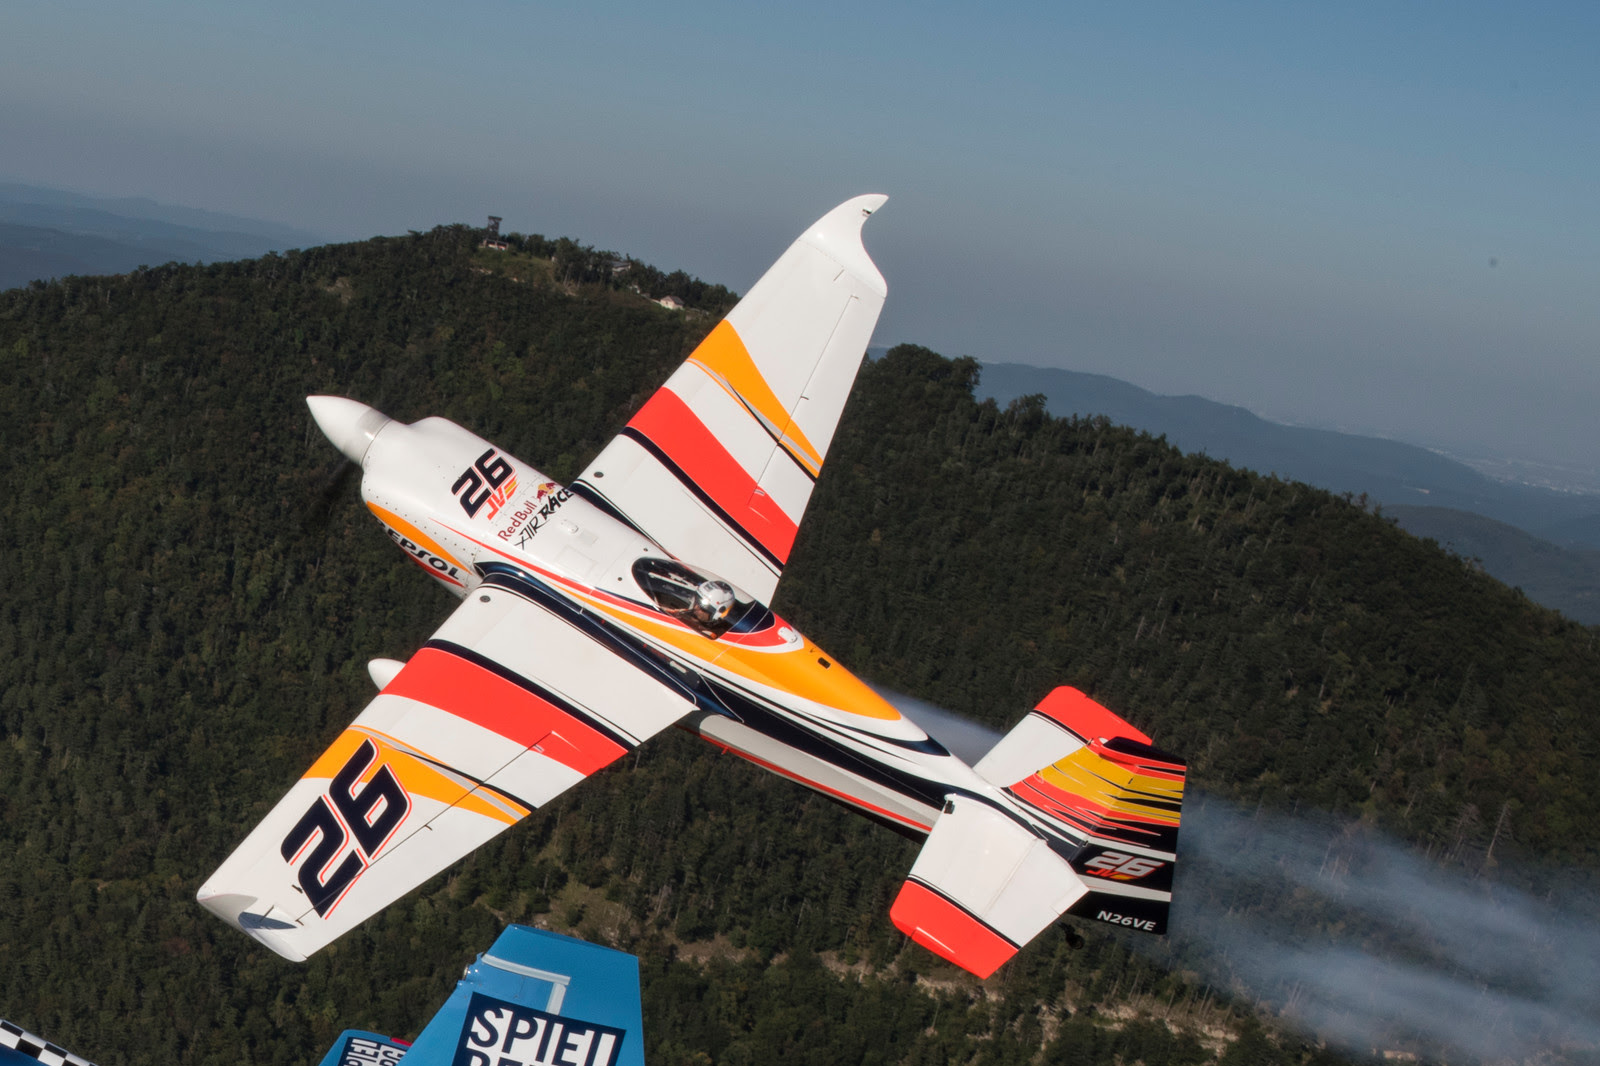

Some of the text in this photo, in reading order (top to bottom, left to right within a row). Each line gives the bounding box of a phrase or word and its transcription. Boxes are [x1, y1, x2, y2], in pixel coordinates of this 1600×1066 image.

[451, 448, 515, 519] 26
[514, 488, 575, 550] AIR RACE
[281, 738, 412, 920] 26
[1084, 851, 1166, 878] 26
[1097, 910, 1156, 931] N26VE
